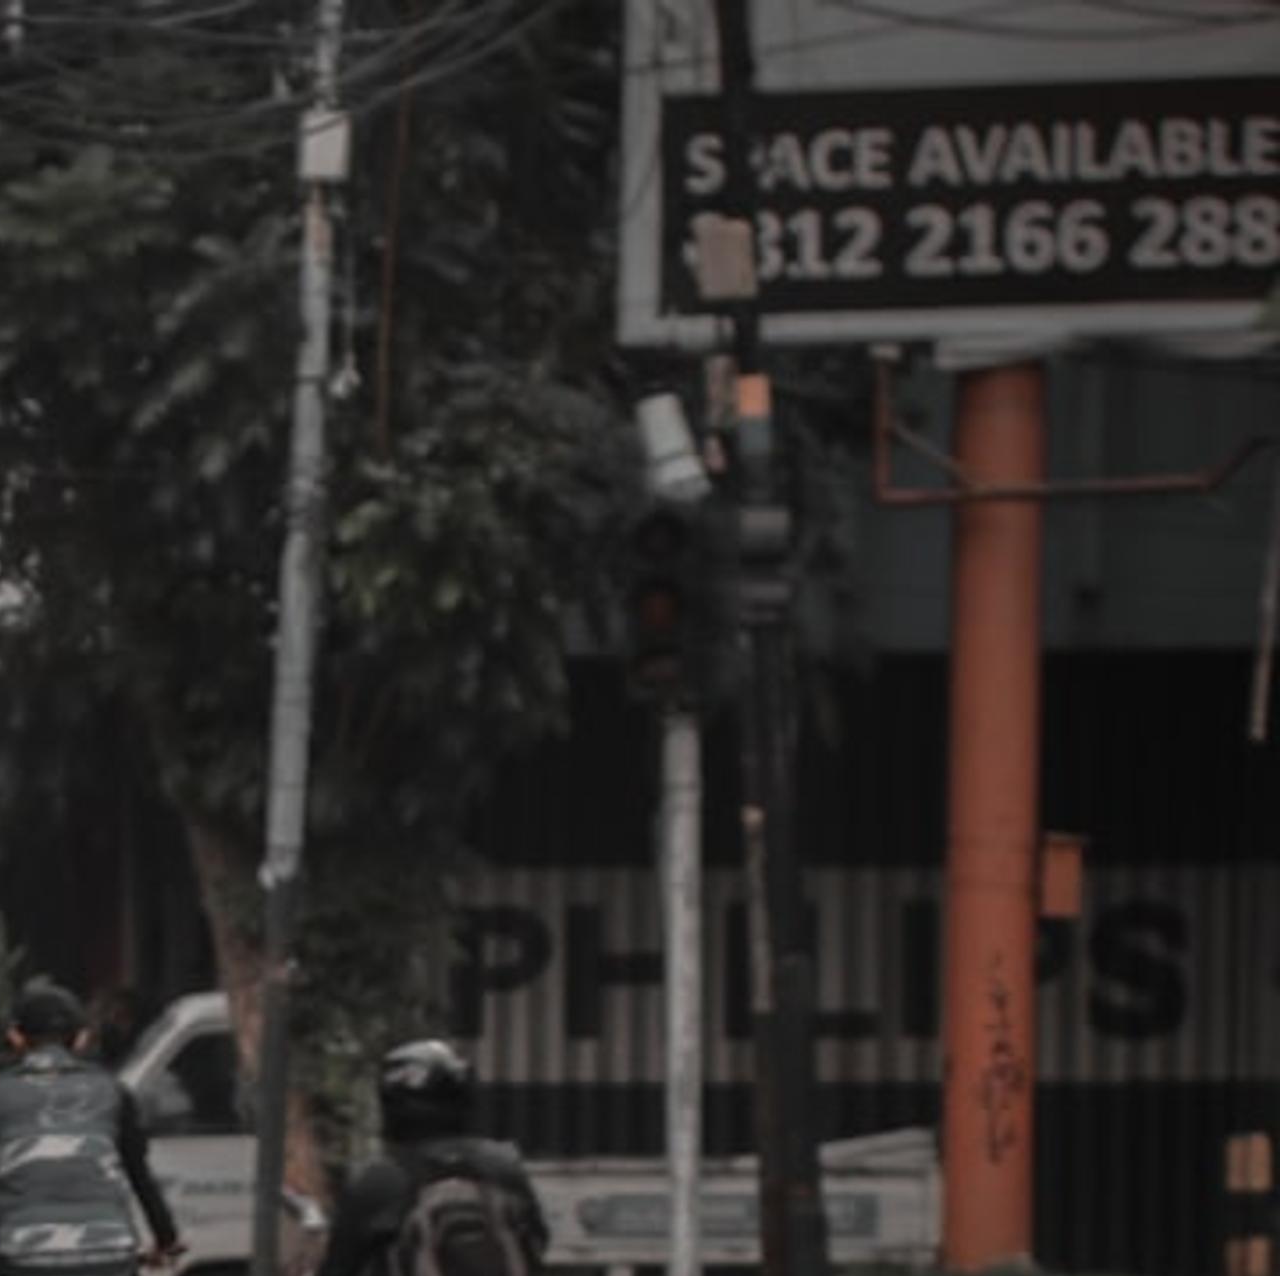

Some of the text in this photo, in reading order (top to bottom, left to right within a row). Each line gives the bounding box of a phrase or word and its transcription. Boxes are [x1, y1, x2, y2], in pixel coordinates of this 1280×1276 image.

[685, 118, 1280, 193] SACE AVAILABLE
[903, 199, 1110, 277] 2166
[1130, 192, 1280, 269] 288
